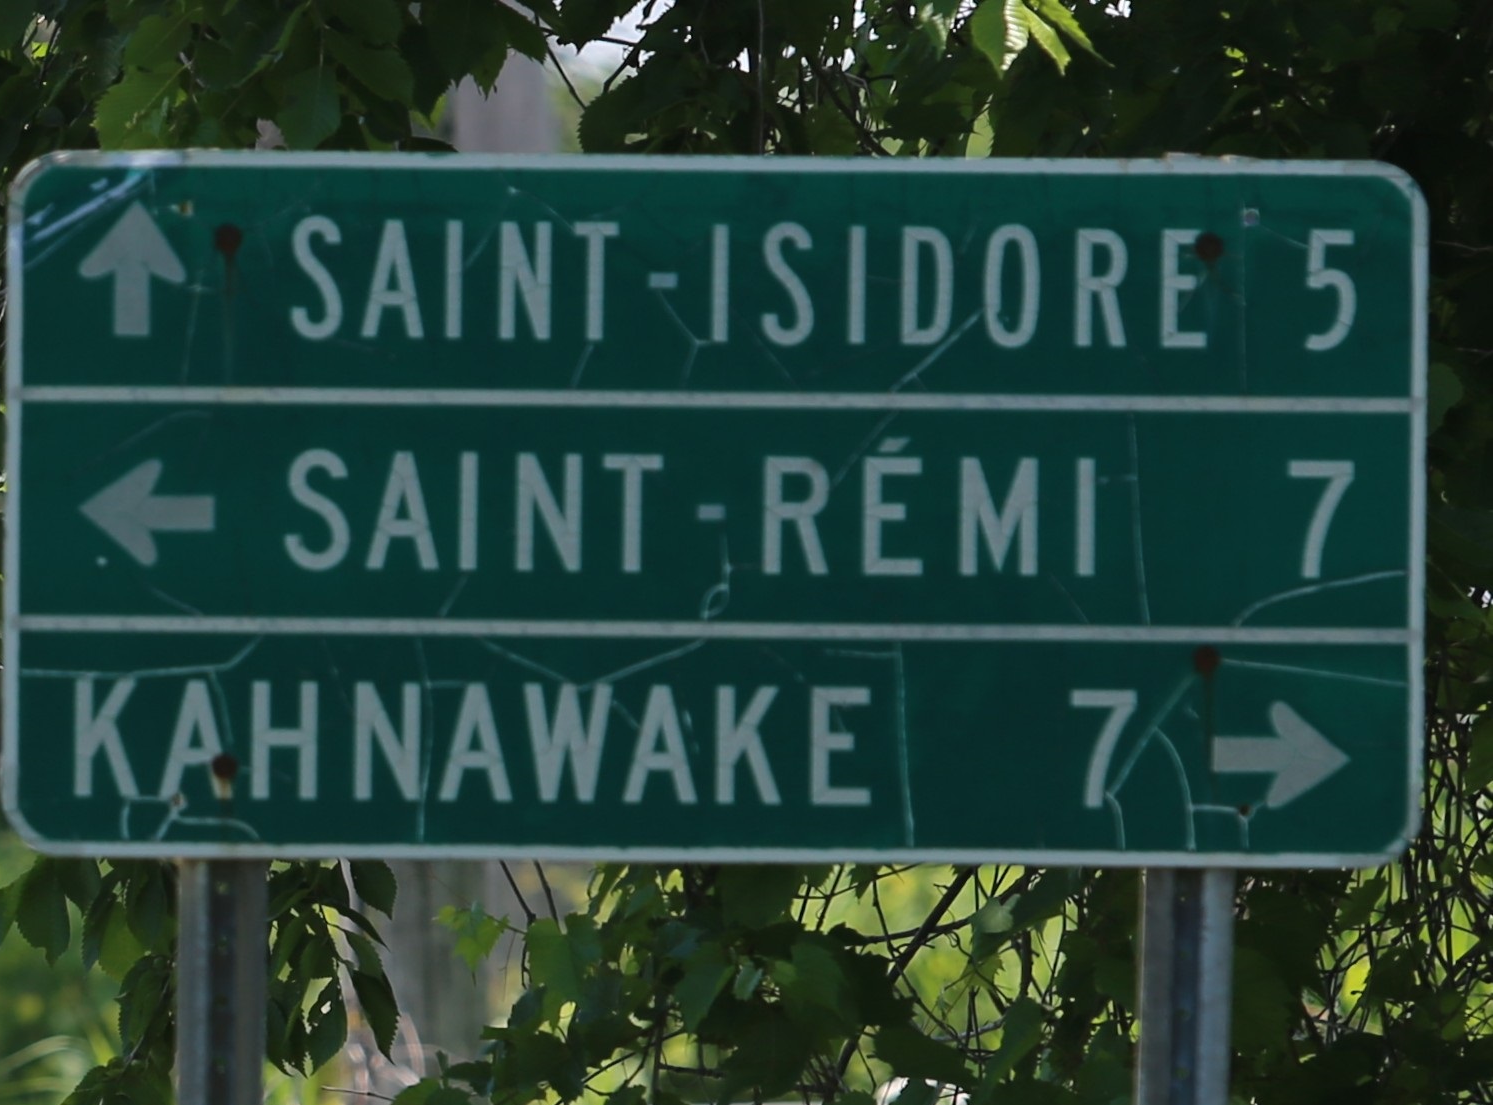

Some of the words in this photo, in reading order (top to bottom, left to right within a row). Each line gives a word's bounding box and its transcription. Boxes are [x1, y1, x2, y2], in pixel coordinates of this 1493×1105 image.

[291, 216, 1207, 349] SAINT-ISIDORE
[1304, 229, 1357, 352] 5
[284, 437, 1094, 576] SAINT-RÉMI
[1288, 459, 1353, 579] 7
[74, 679, 870, 805] KAHNAWAKE
[1071, 689, 1135, 808] 7
